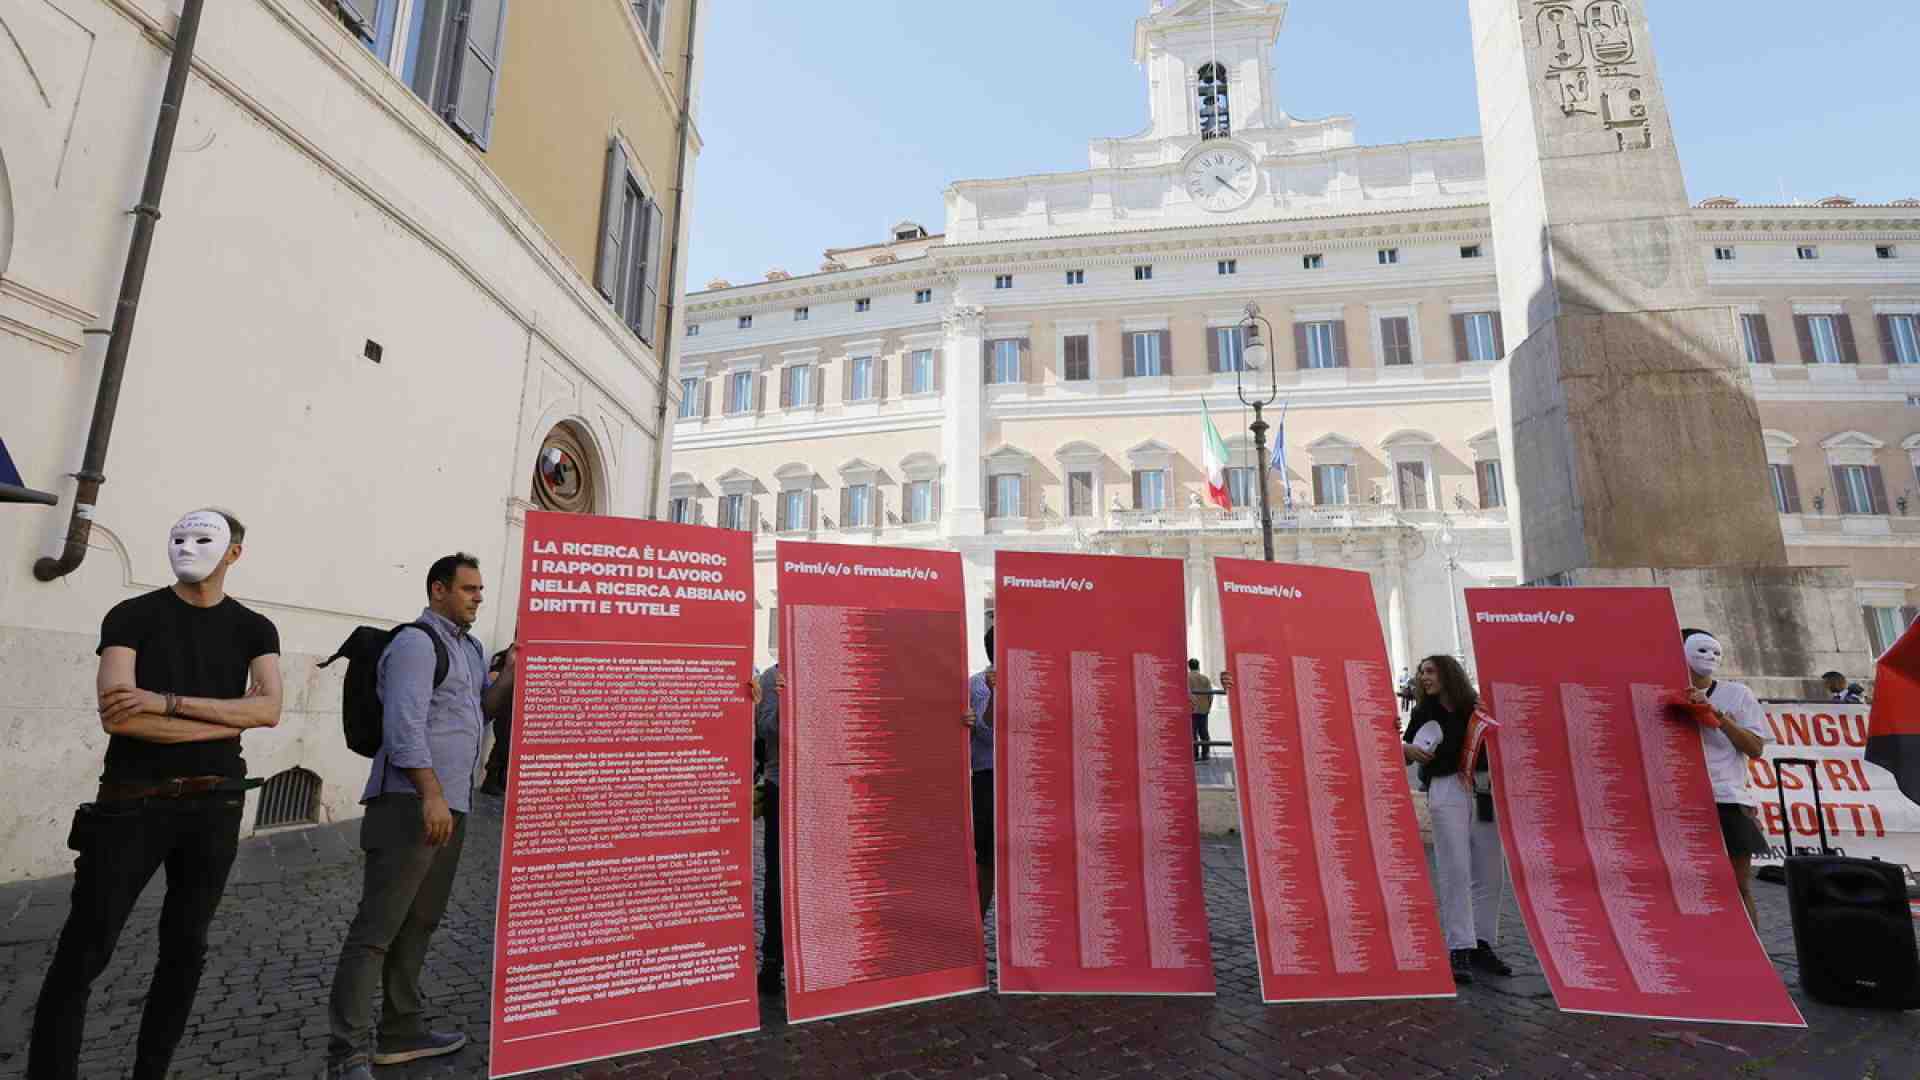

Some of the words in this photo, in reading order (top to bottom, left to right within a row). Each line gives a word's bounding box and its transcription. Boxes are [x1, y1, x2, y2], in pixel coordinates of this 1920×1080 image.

[533, 540, 558, 554] LA
[562, 542, 640, 559] RICERCA
[643, 544, 655, 561] È
[657, 549, 727, 566] LAVORO:
[531, 560, 538, 572] I
[542, 560, 633, 577] RAPPORTI
[637, 564, 654, 578] DI
[657, 567, 723, 583] LAVORO
[530, 579, 592, 593] NELLA
[596, 582, 670, 598] RICERCA
[675, 588, 747, 602] ABBIANO
[529, 598, 596, 612] DIRITTI
[600, 601, 612, 614] E
[615, 601, 681, 616] TUTELE
